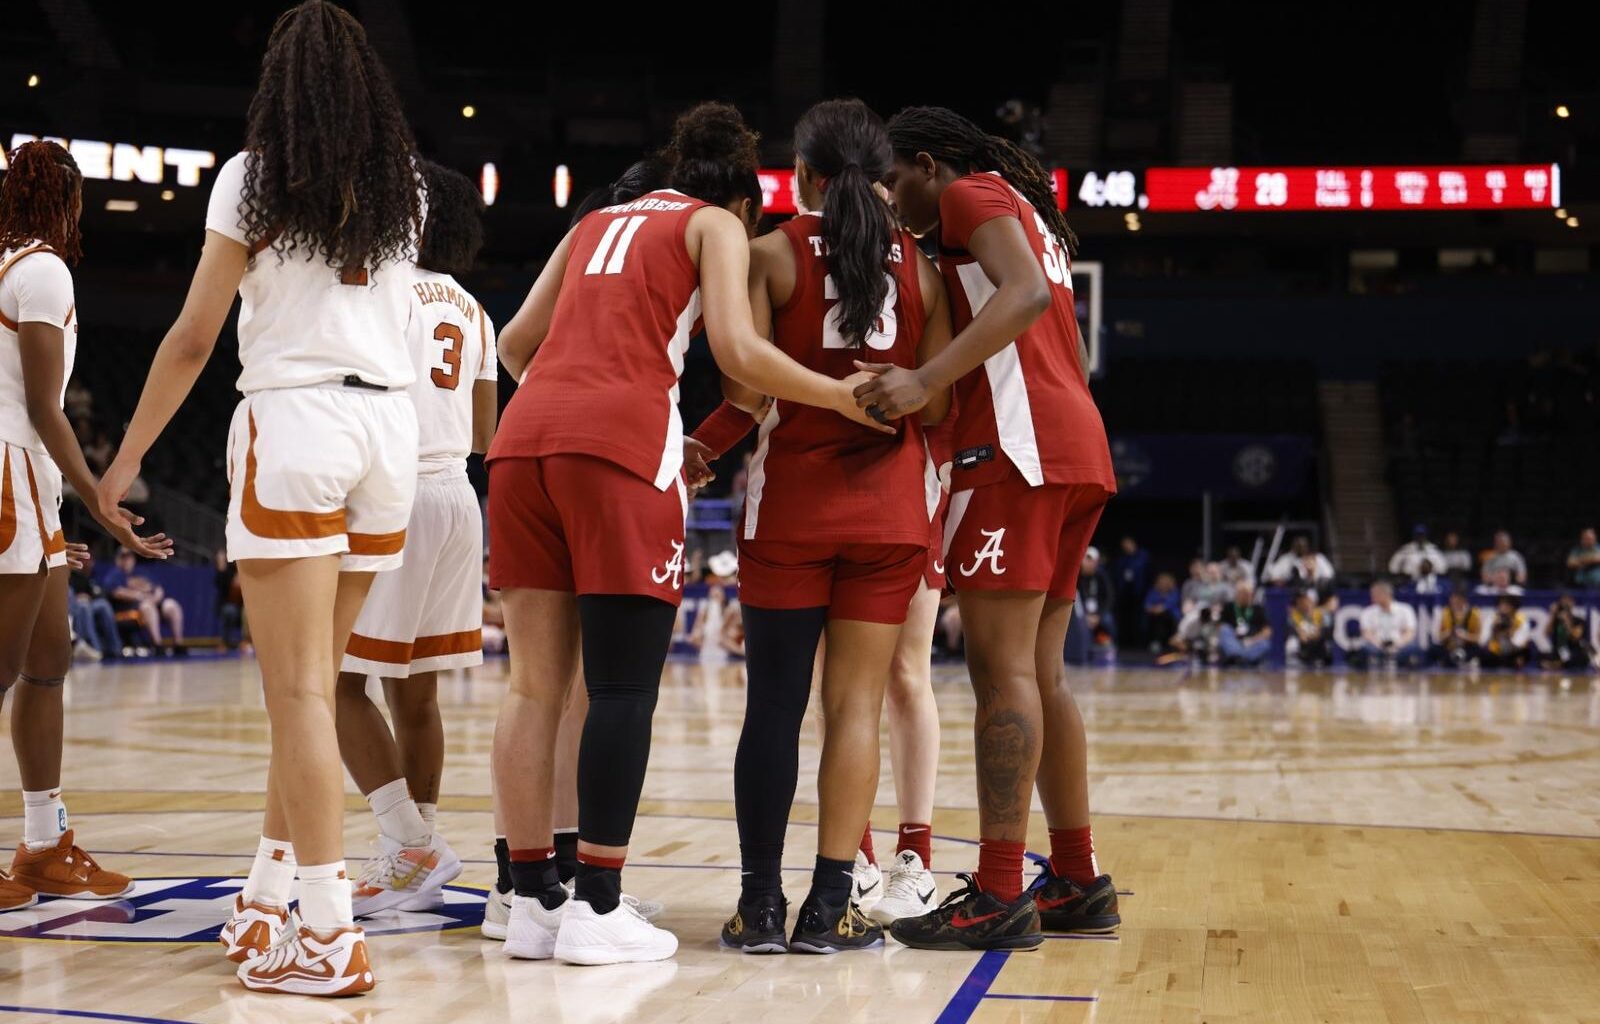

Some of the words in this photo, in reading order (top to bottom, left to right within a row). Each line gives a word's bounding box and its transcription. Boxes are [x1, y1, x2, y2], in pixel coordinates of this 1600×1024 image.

[0, 133, 215, 187] ENT
[584, 215, 648, 275] 11
[413, 281, 475, 323] HARMON
[430, 321, 464, 391] 3
[651, 538, 685, 590] A
[960, 527, 1007, 577] A
